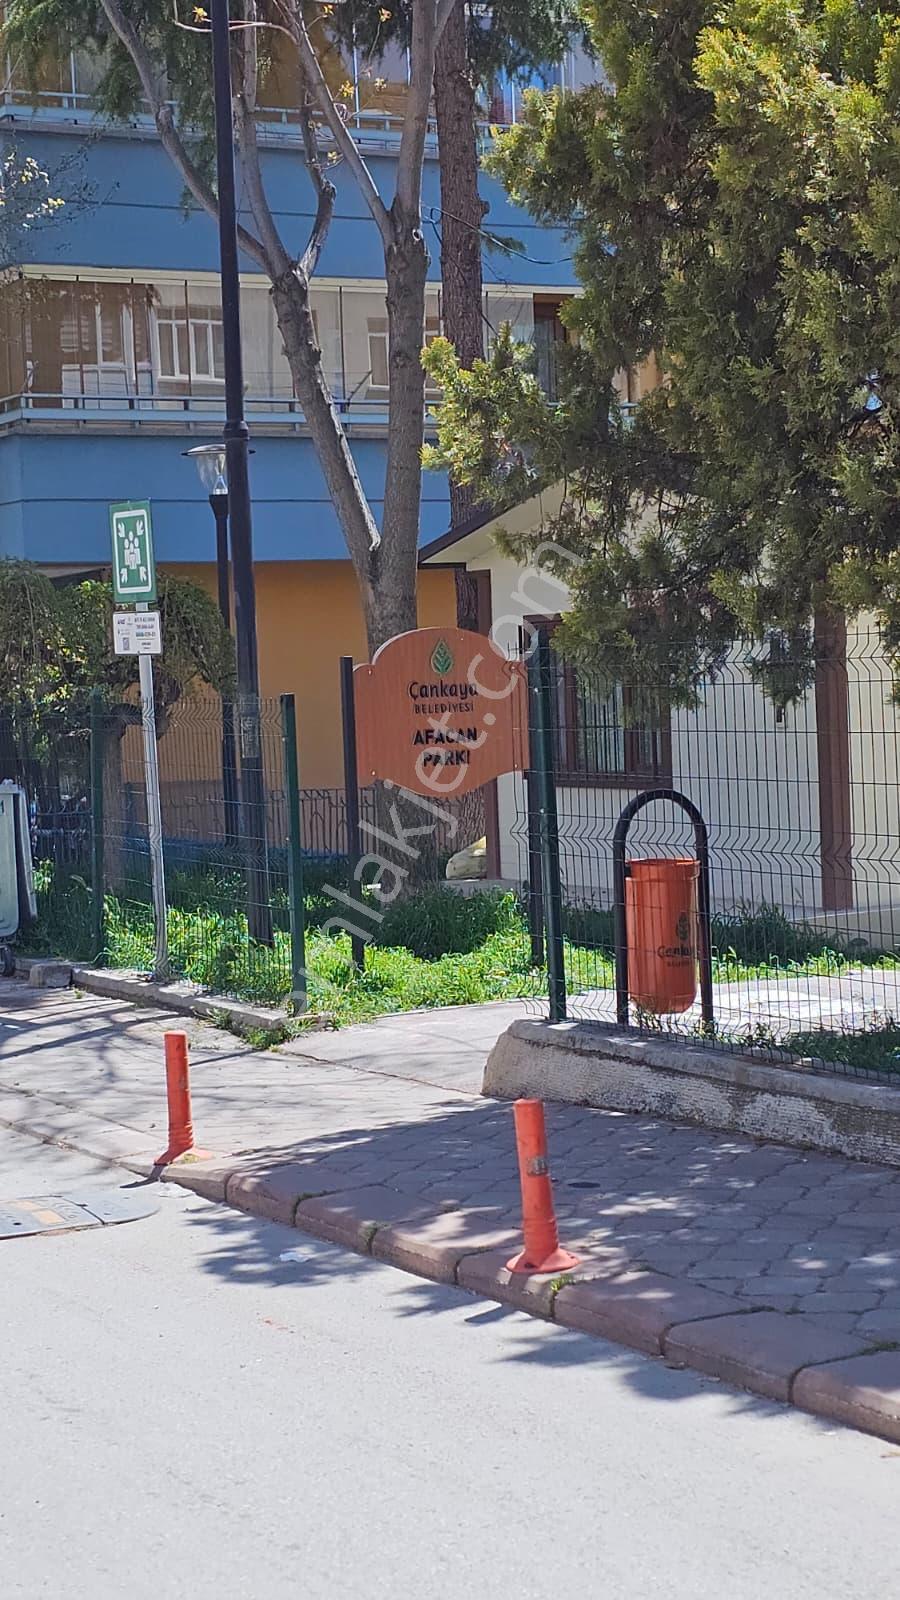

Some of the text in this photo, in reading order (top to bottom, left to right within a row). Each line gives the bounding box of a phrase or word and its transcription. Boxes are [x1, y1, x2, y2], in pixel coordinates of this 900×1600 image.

[409, 679, 479, 701] Çankaya
[413, 727, 478, 746] AFACAN
[423, 750, 471, 768] PARKI
